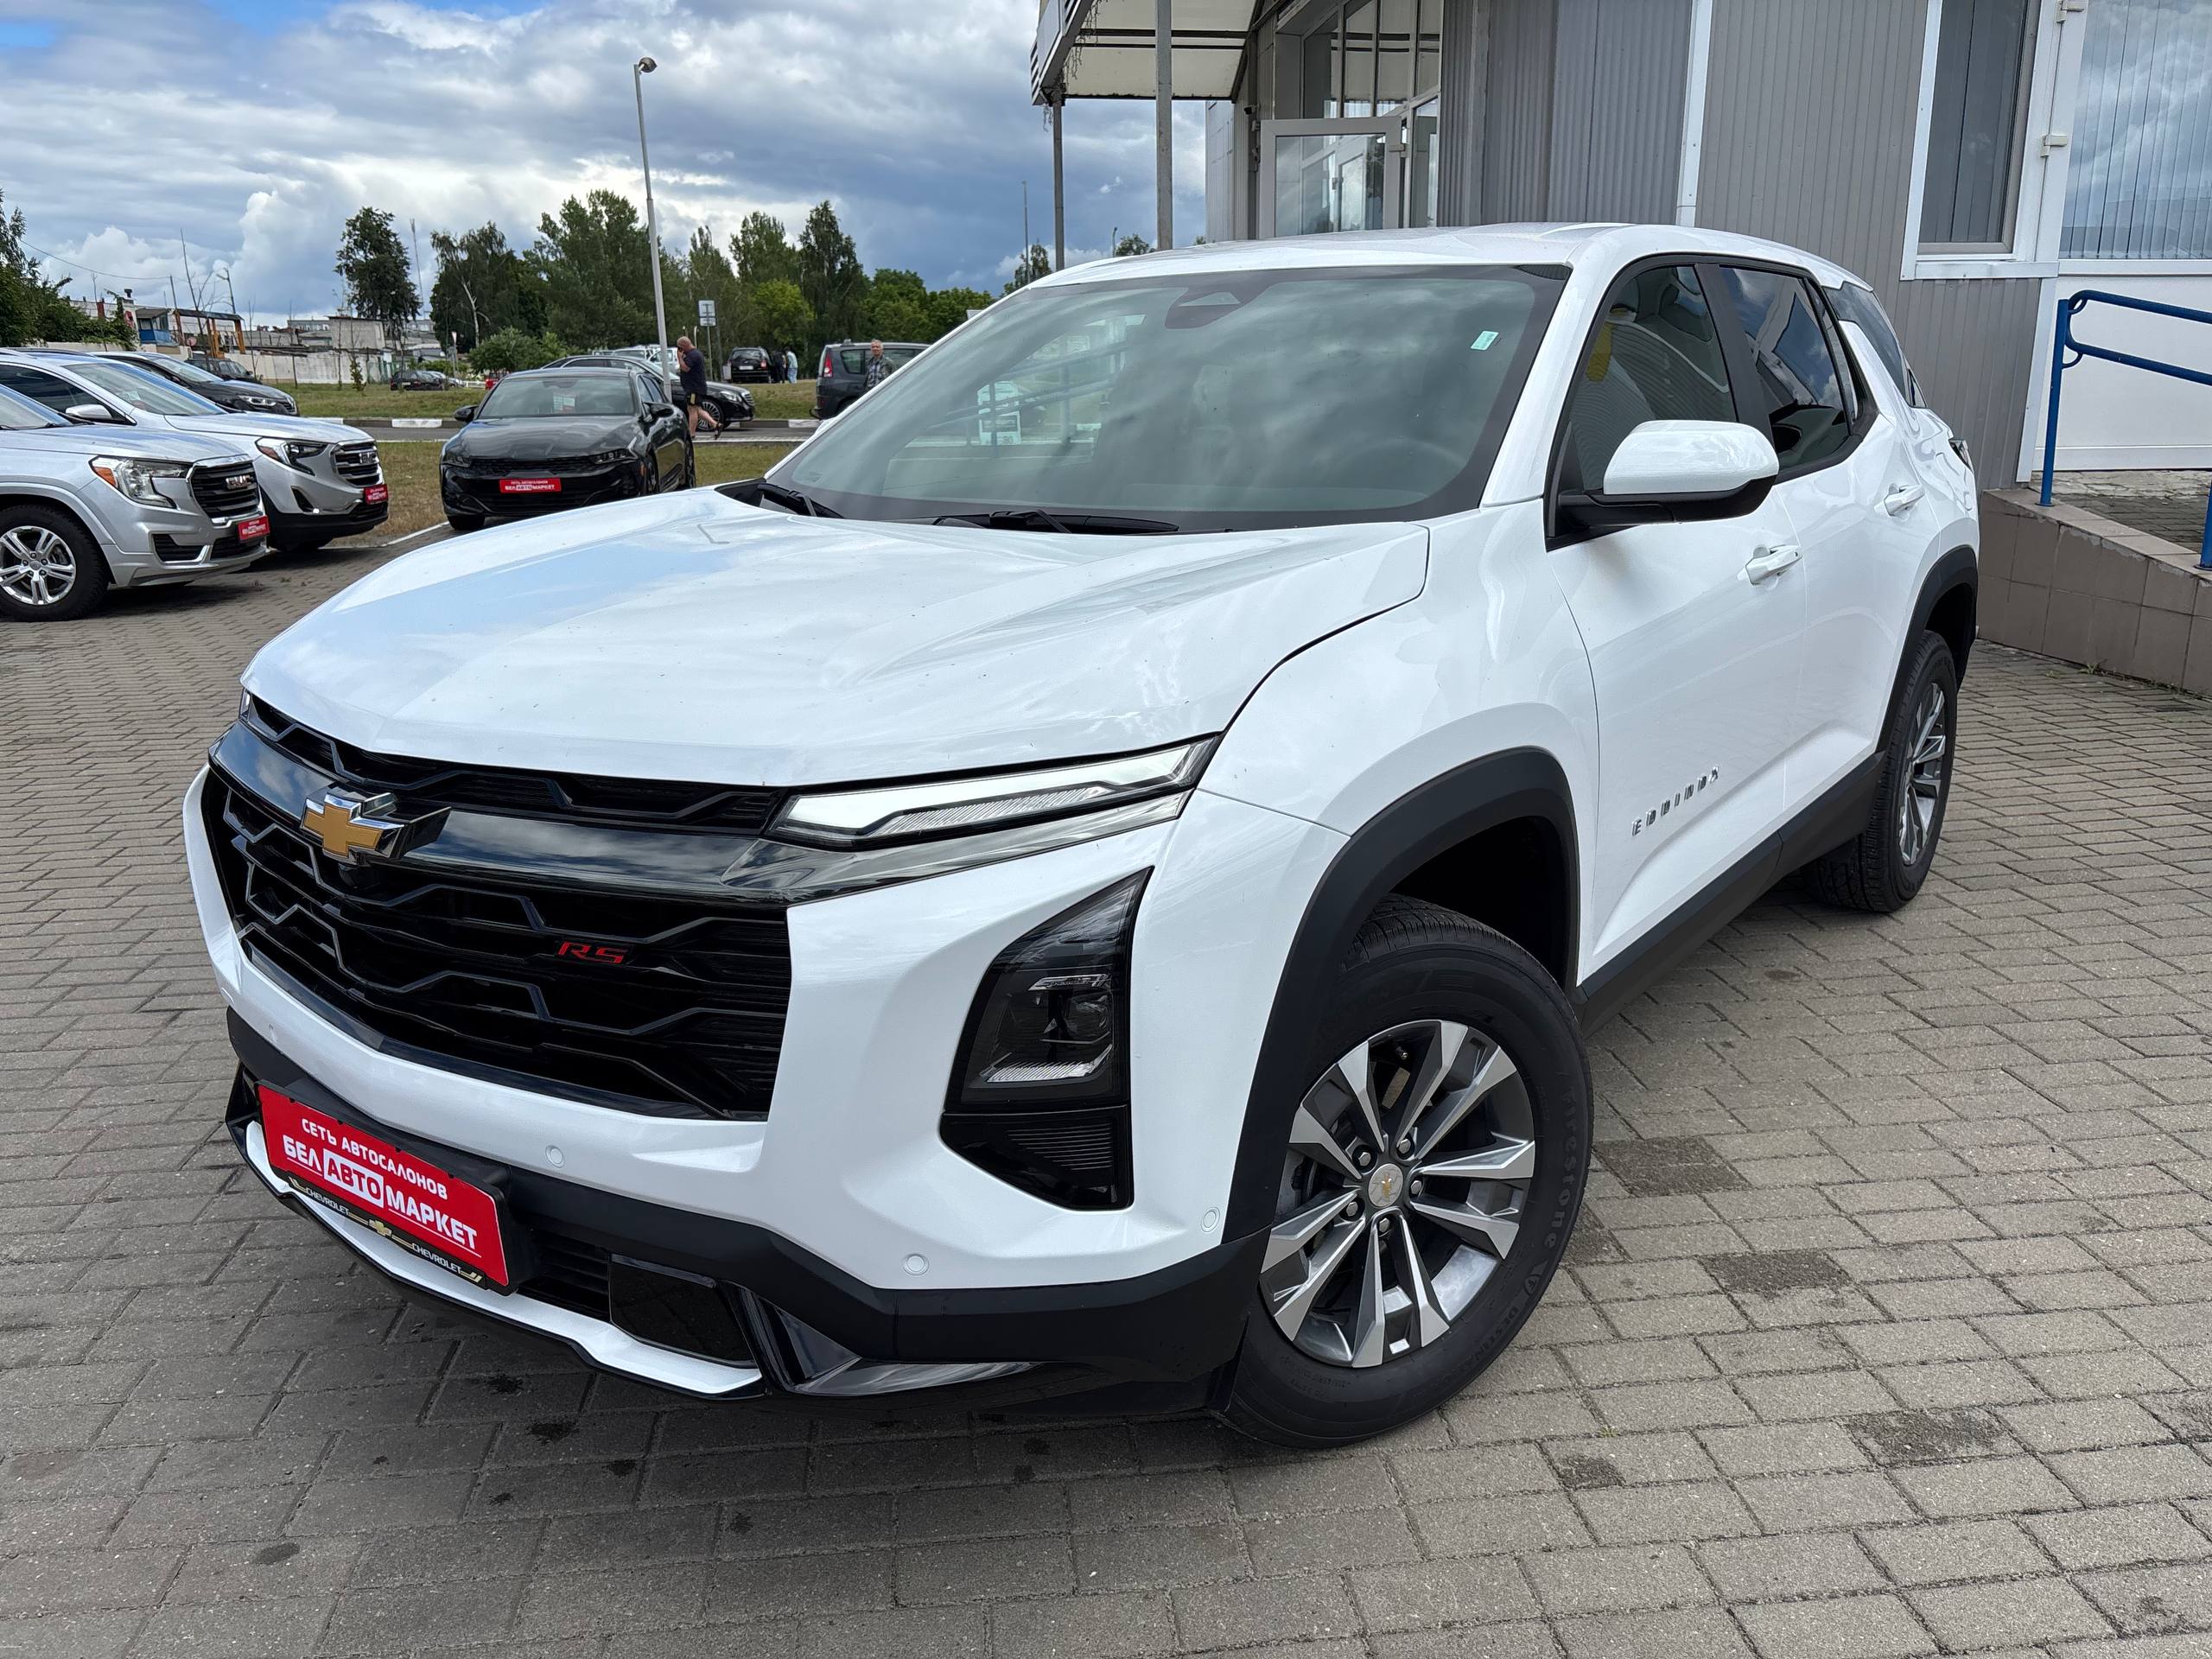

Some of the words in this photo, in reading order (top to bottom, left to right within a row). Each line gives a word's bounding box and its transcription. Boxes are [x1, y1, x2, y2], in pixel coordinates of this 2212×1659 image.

[1631, 766, 1719, 836] EQUINOX
[557, 940, 628, 965] RS
[301, 1118, 337, 1147] СЕТЬ
[341, 1137, 449, 1200] АВТОСАЛОНОВ
[305, 1188, 350, 1217] CHEVROLET
[411, 1243, 462, 1274] CHEVROLET
